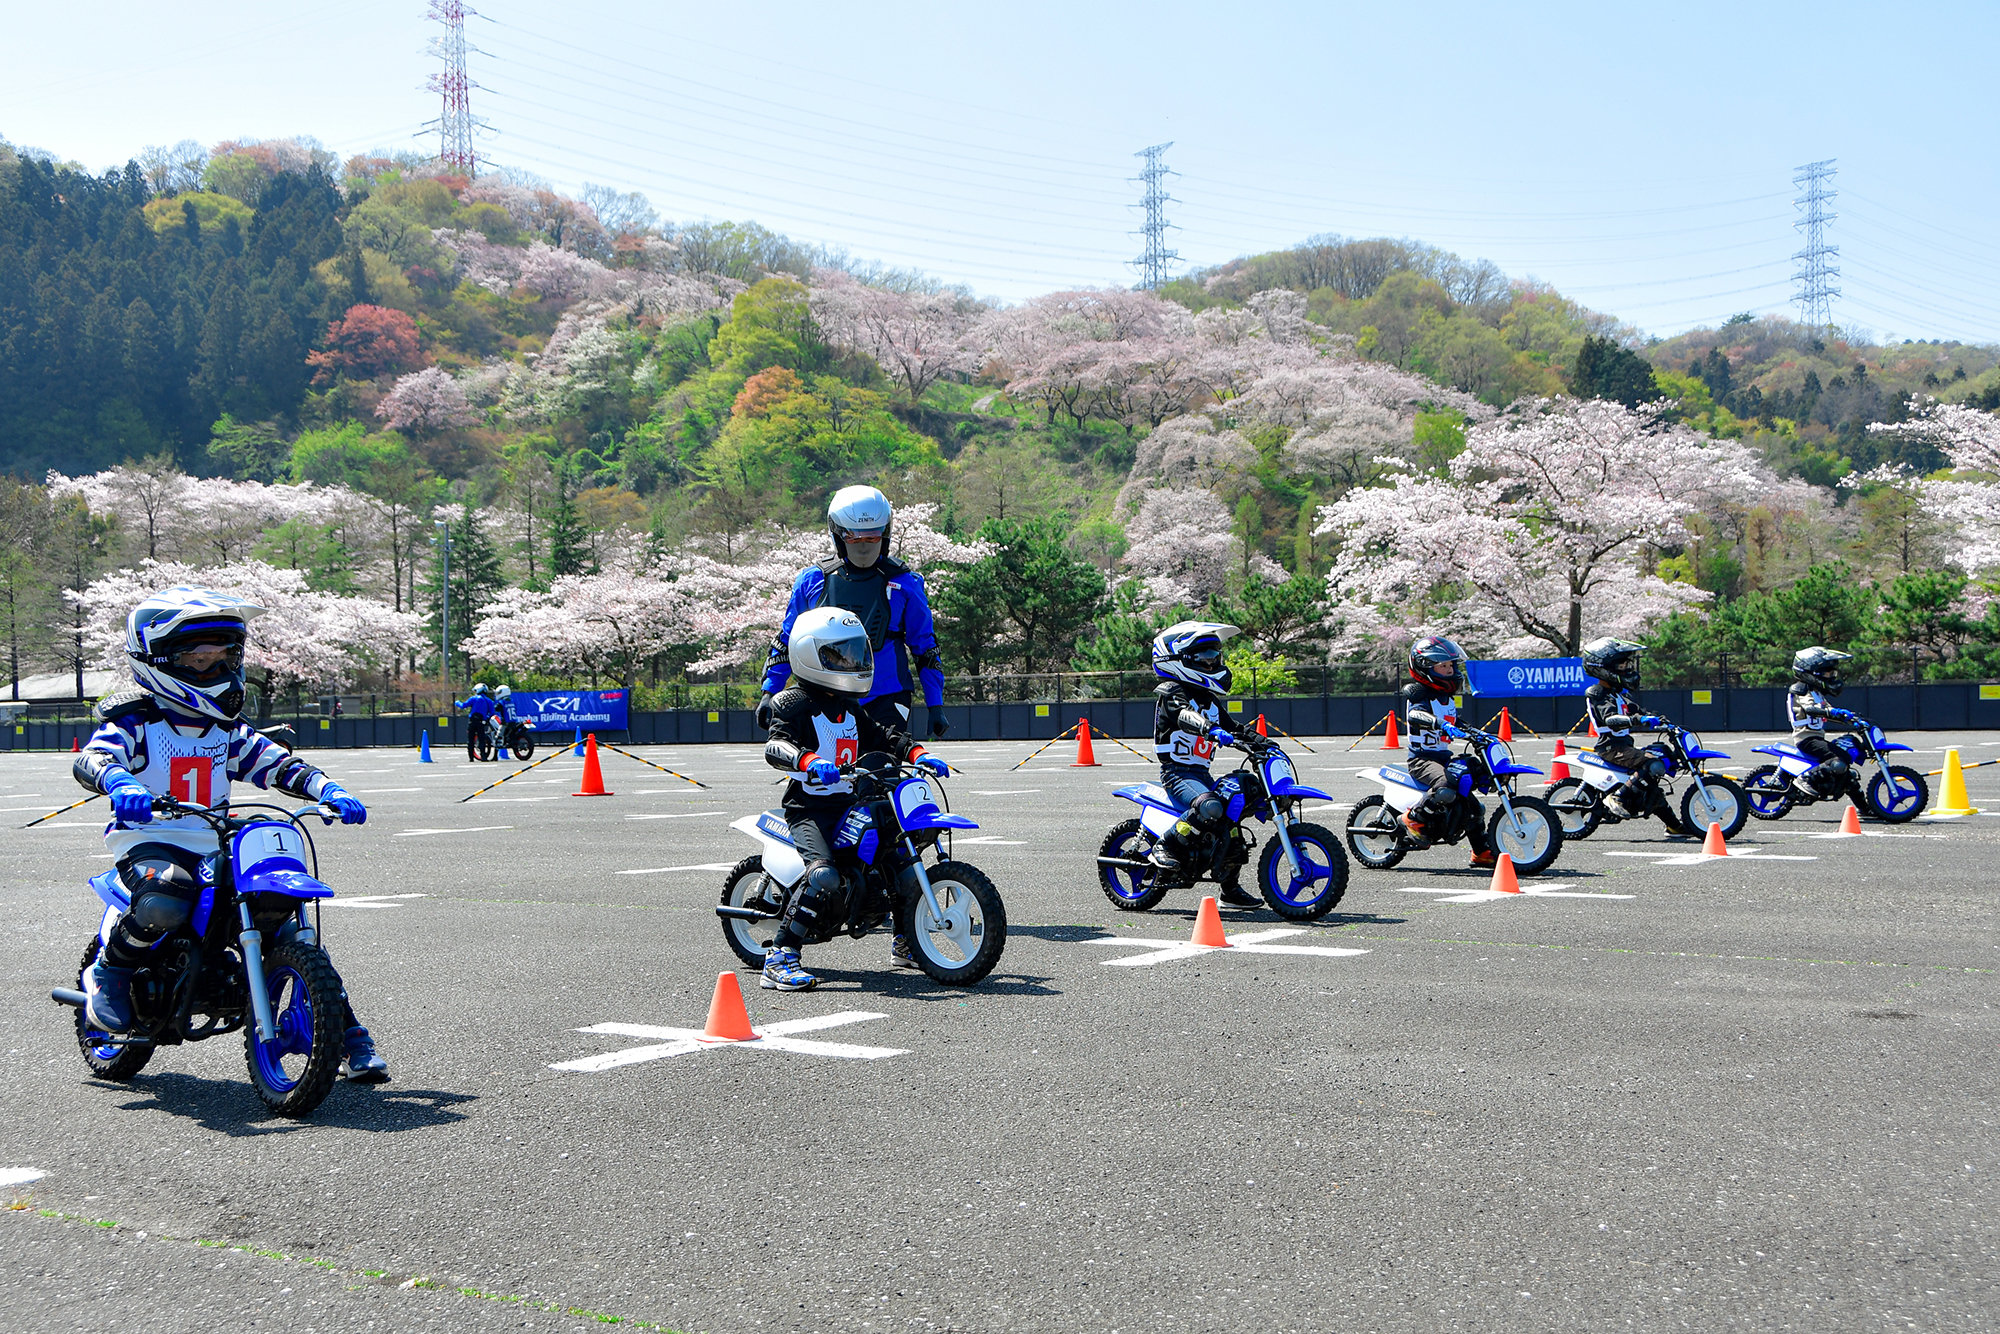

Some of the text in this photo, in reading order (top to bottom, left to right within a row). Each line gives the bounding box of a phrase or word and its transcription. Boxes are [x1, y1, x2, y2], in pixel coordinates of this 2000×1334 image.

[1525, 666, 1584, 683] YAMAHA
[506, 707, 517, 720] 15
[540, 713, 567, 723] Riding
[569, 712, 610, 723] Academy
[1385, 769, 1406, 782] YAMAHA
[182, 768, 198, 803] 1
[918, 786, 930, 800] 2
[765, 818, 790, 838] YAMAHA
[272, 832, 288, 852] 1
